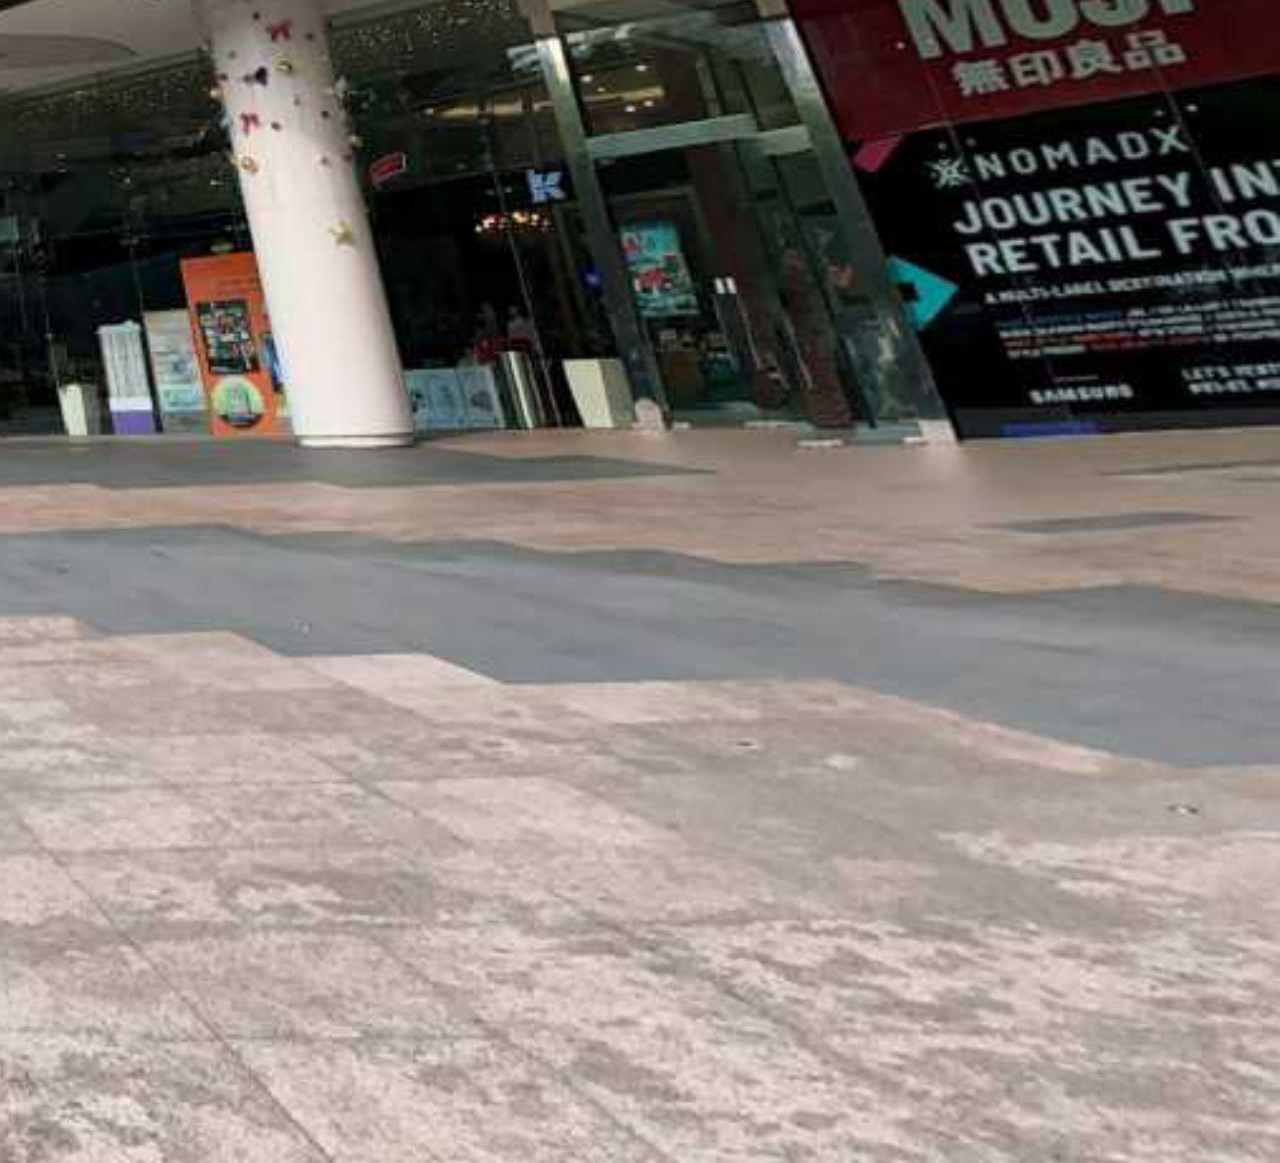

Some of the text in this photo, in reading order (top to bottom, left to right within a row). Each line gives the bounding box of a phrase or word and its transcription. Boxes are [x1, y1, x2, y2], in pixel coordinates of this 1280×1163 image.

[951, 30, 1186, 96] 無印良品
[974, 125, 1190, 180] NOMADX
[953, 171, 1190, 234] JOURNEY
[963, 226, 1162, 277] RETAIL
